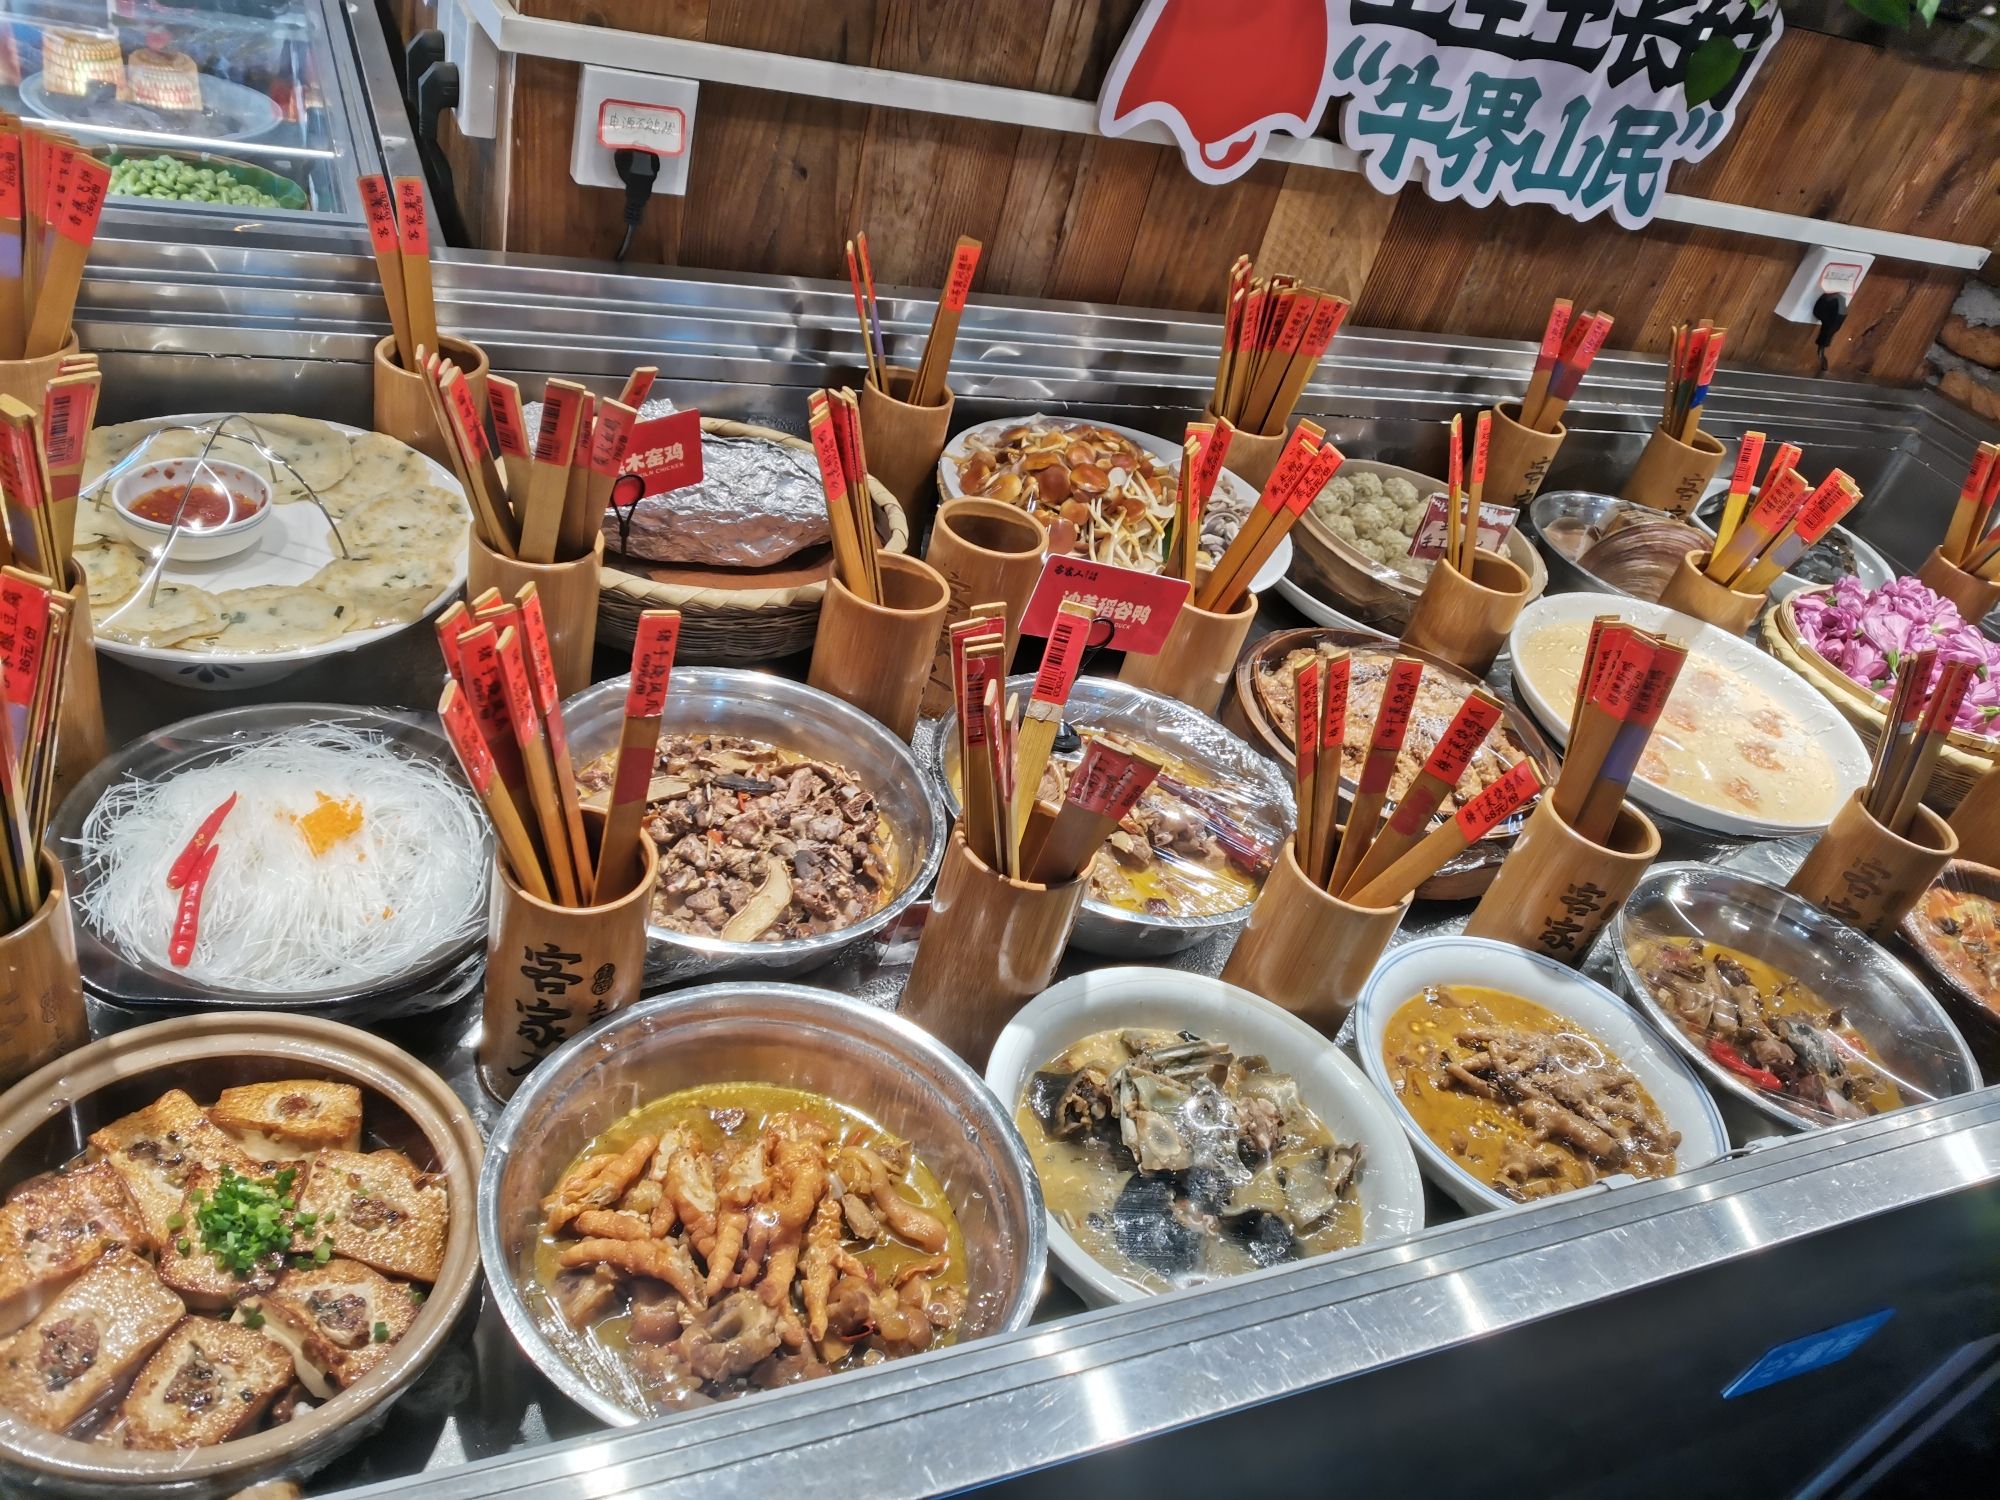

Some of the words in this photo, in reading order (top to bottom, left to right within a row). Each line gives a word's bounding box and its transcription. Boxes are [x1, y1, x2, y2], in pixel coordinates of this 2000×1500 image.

[618, 443, 684, 475] 木窑鸡
[1306, 467, 1331, 497] 68元/份
[1459, 725, 1487, 764] 68元/份
[1484, 793, 1519, 824] 68元/份
